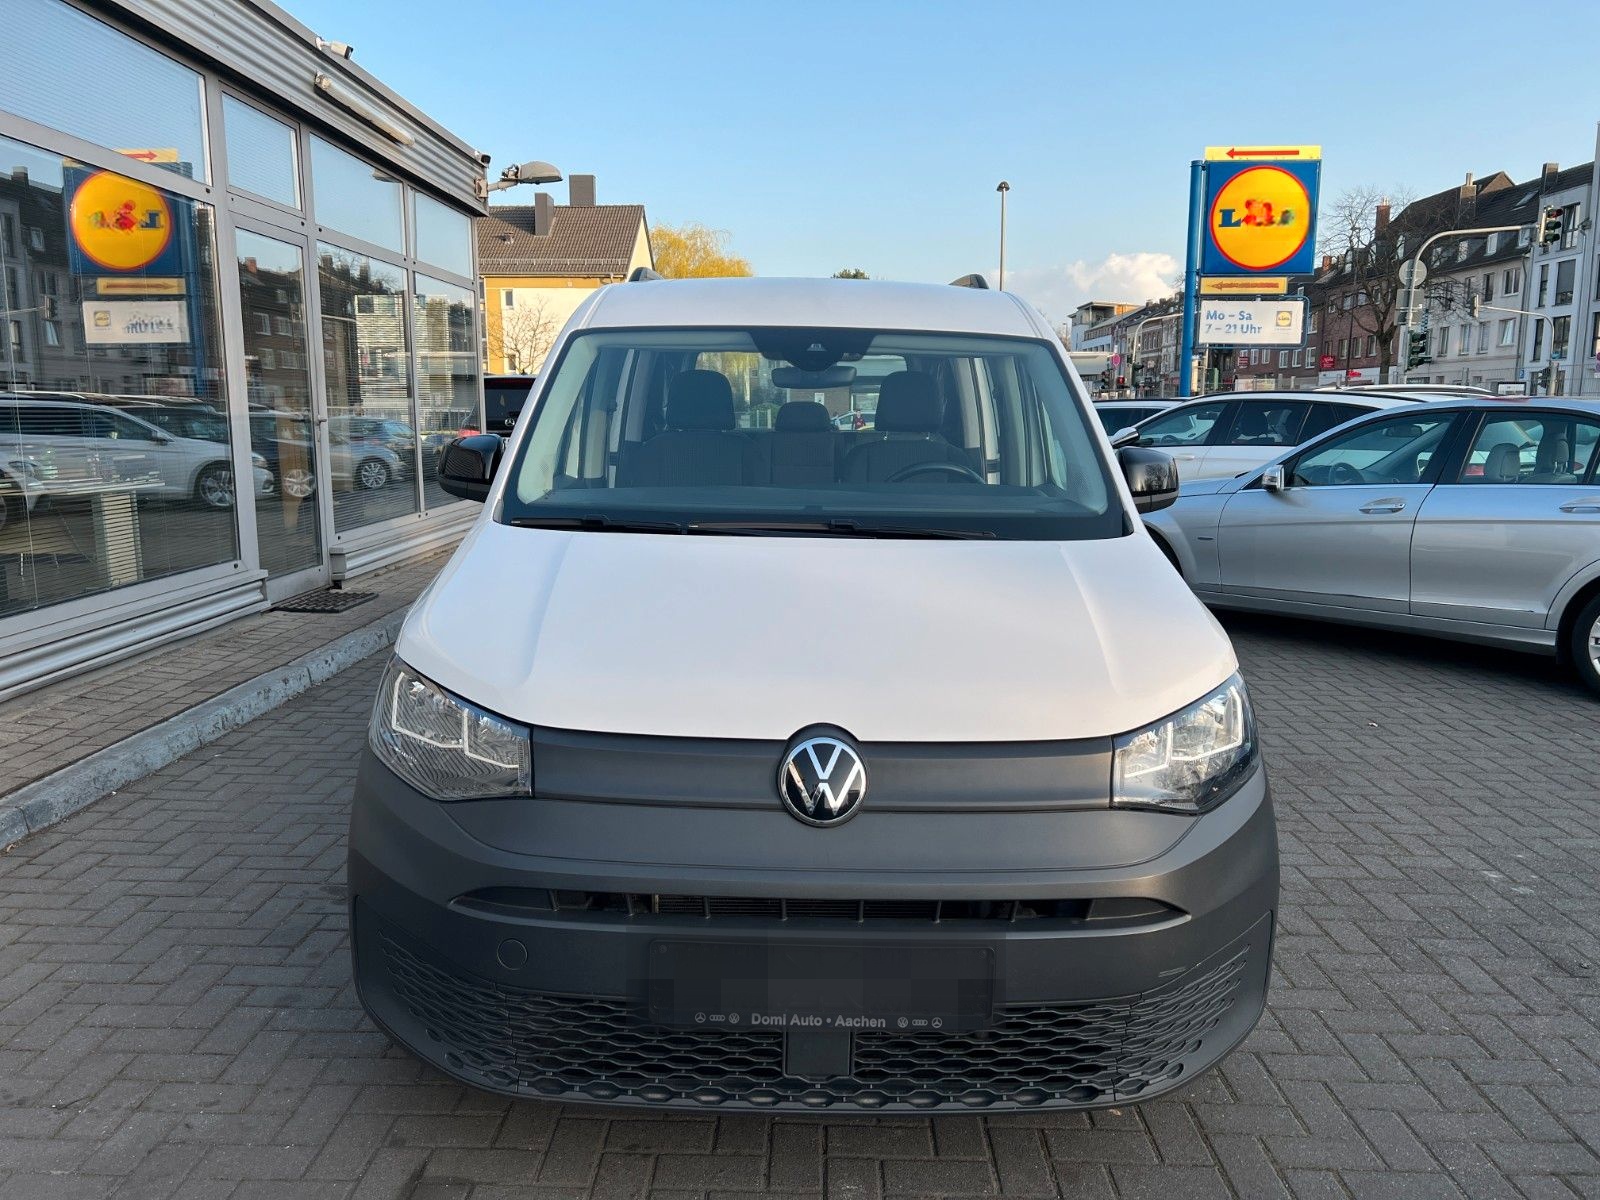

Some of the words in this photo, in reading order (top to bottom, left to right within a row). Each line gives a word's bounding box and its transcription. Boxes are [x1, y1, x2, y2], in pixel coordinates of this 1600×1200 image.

[1206, 310, 1225, 321] Mo
[1238, 310, 1253, 321] Sa
[1240, 323, 1263, 334] Uhr
[751, 1013, 787, 1026] Domi
[789, 1013, 823, 1027] Auto
[834, 1014, 887, 1028] Aachen
